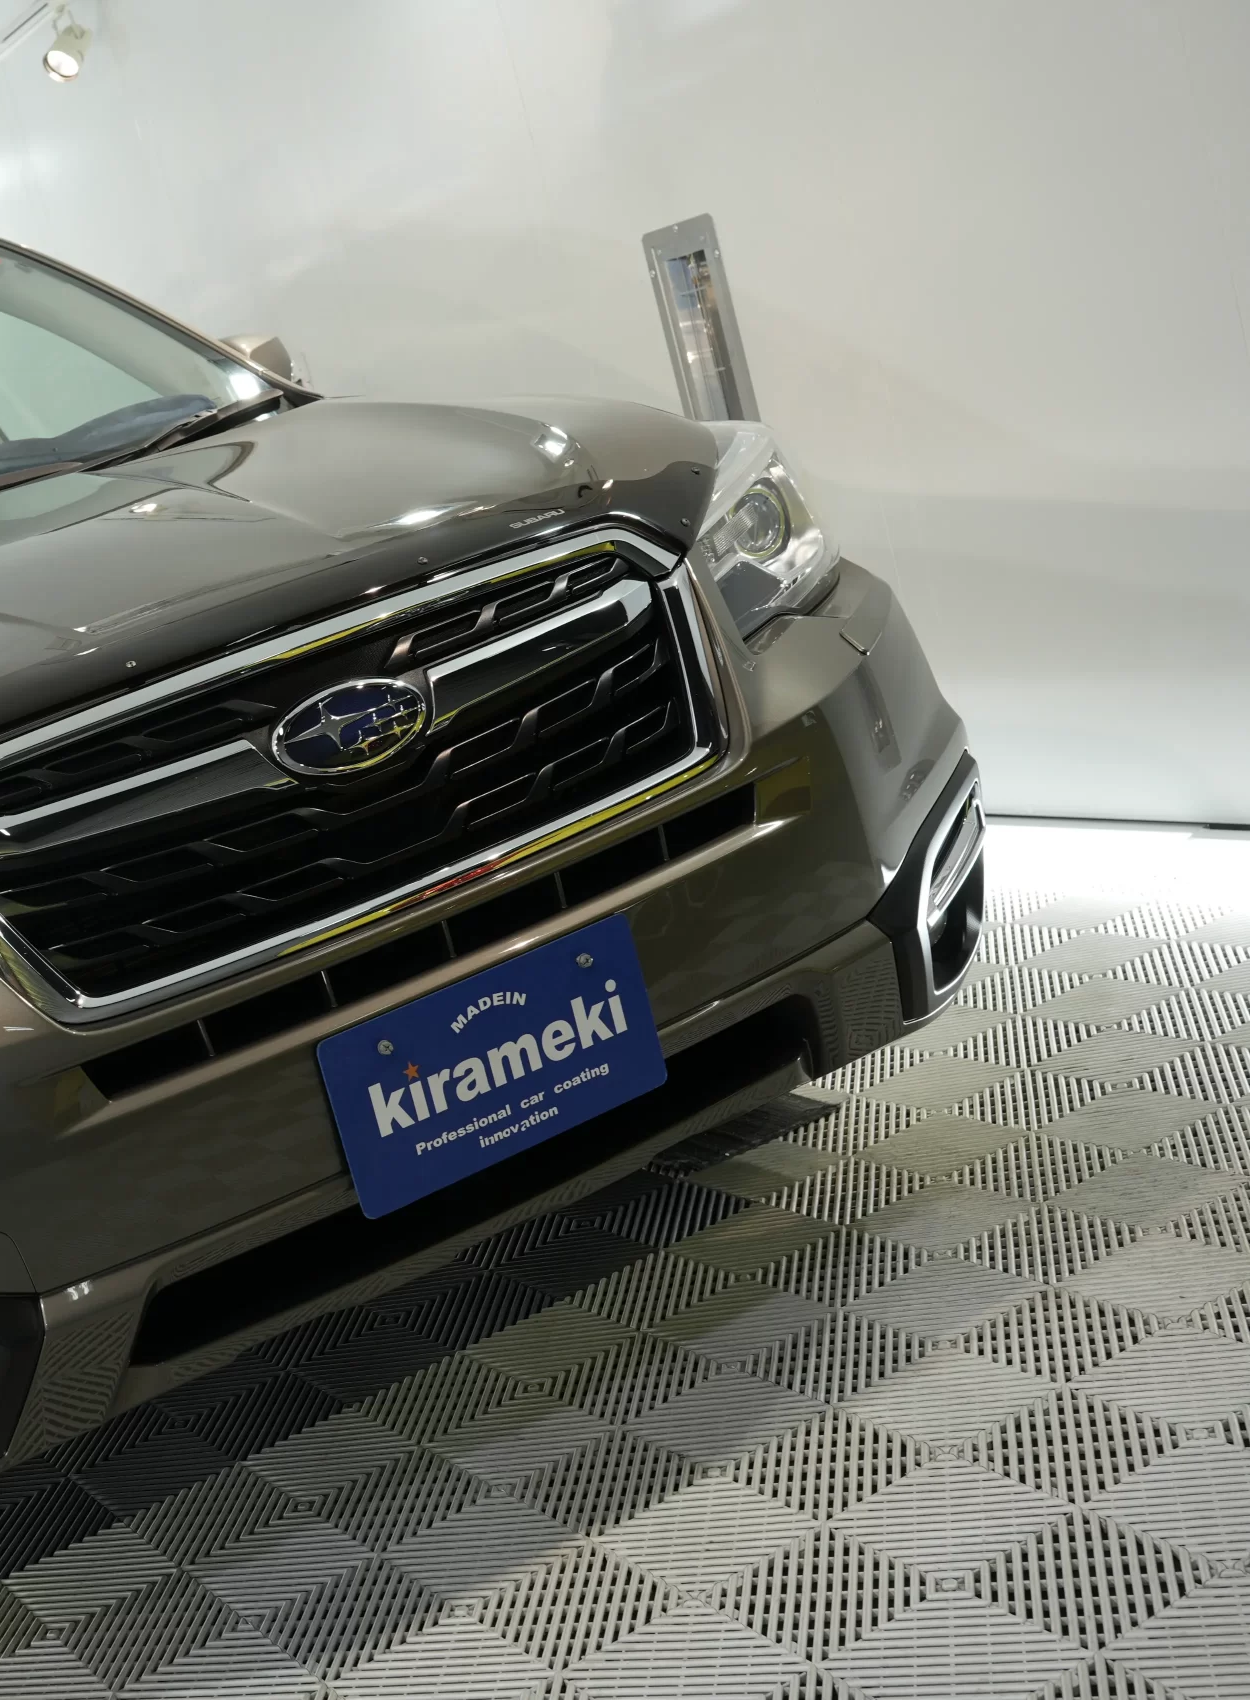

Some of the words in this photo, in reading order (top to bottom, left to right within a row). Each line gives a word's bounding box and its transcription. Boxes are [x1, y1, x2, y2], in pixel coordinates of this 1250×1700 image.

[509, 508, 565, 528] SUBARU
[367, 979, 629, 1138] kirameki
[415, 1104, 512, 1156] Professional
[519, 1091, 546, 1110] car
[553, 1063, 610, 1095] coating
[479, 1106, 559, 1148] innovation
